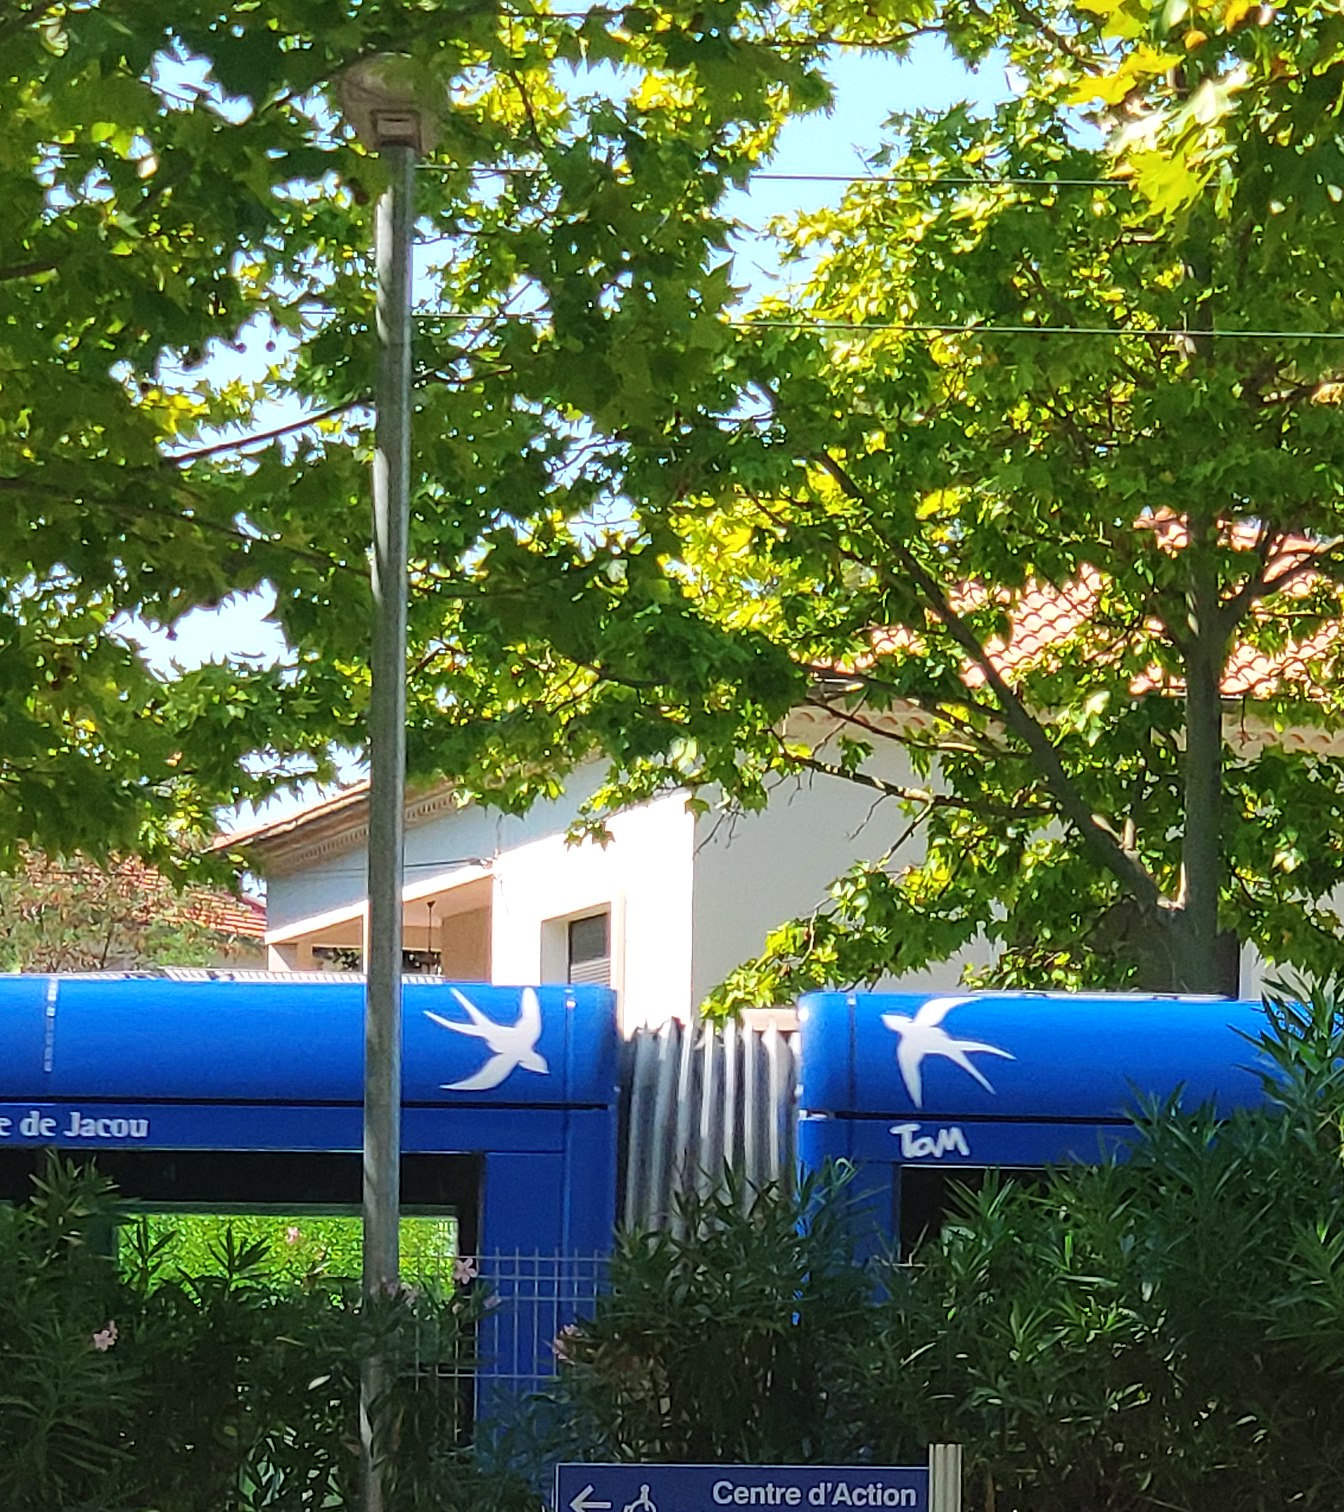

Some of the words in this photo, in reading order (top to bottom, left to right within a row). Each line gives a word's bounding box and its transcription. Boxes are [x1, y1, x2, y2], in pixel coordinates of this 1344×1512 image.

[19, 1110, 56, 1137] de
[63, 1111, 149, 1138] Jacou
[712, 1480, 801, 1506] Centre
[808, 1481, 917, 1507] d'Action
